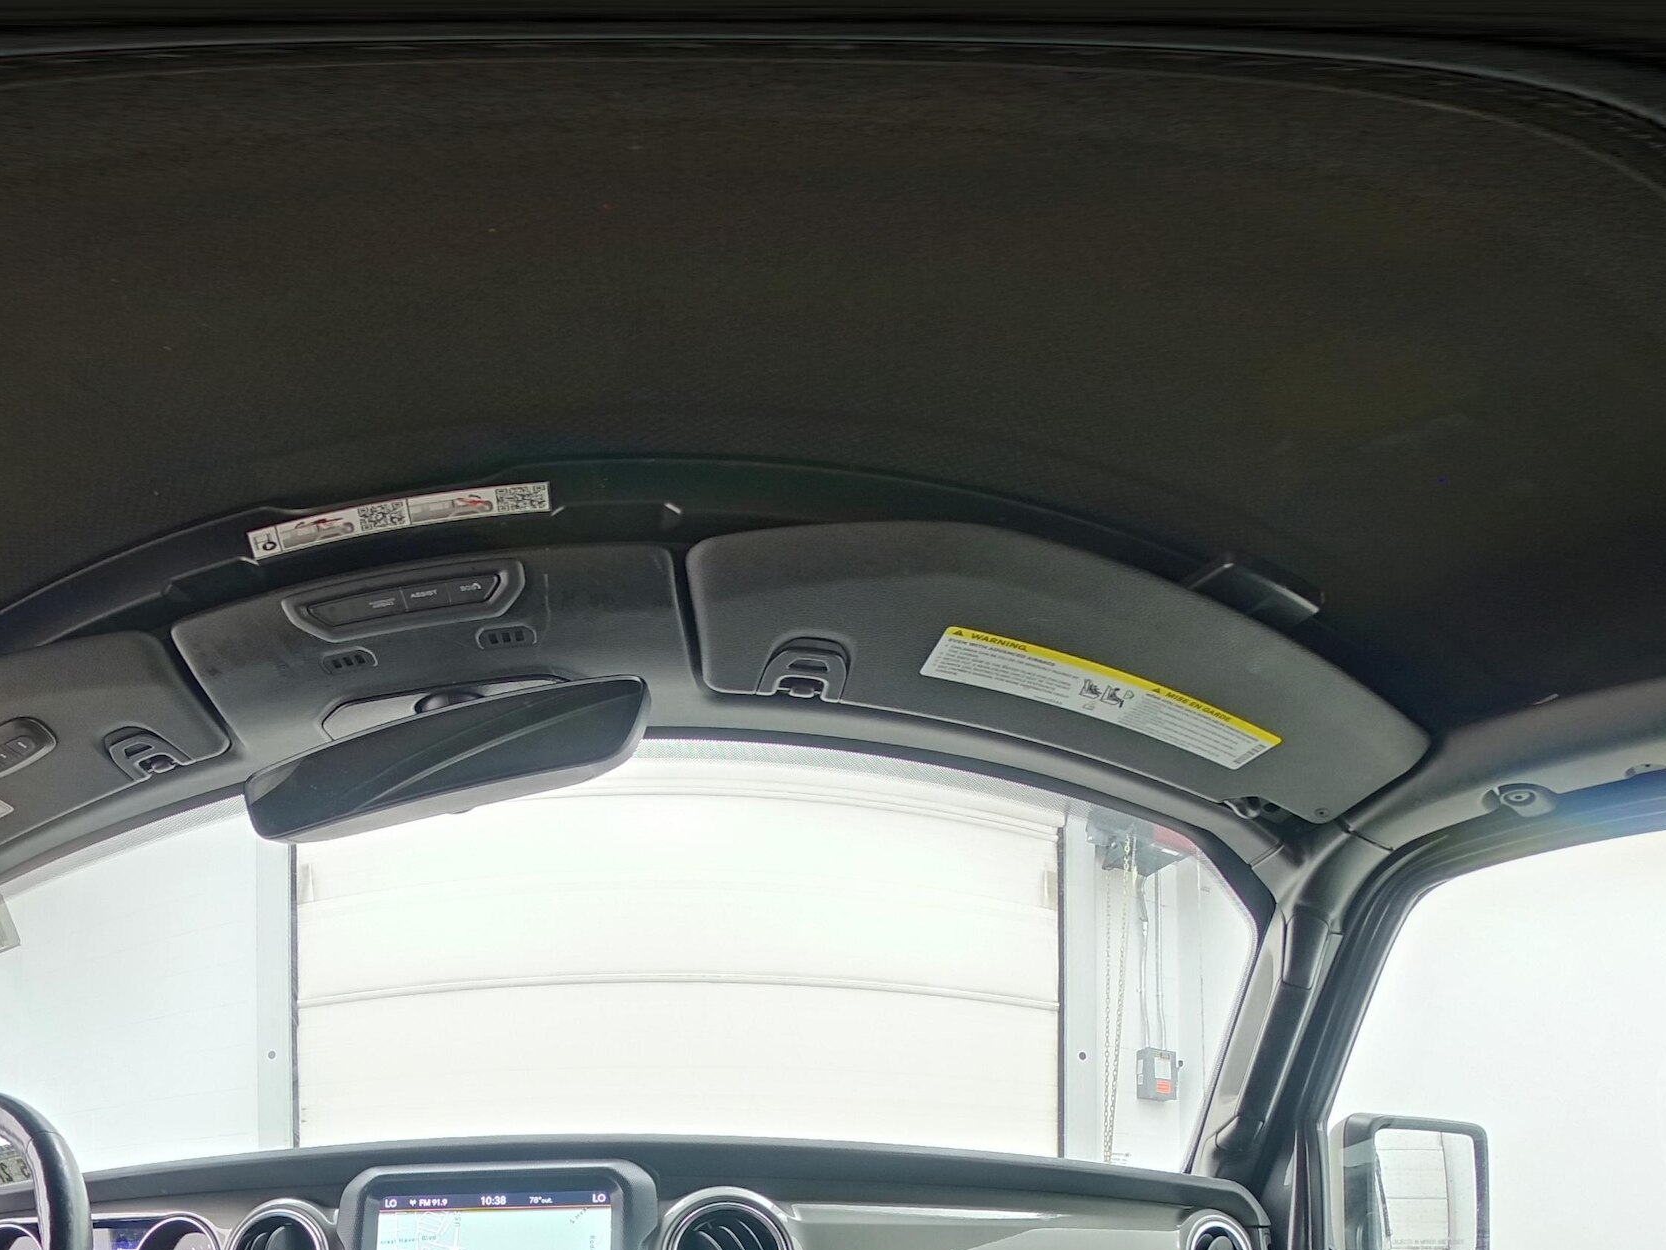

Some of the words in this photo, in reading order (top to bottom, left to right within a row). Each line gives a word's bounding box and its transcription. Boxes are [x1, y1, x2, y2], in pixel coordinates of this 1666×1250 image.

[410, 589, 437, 598] ASSIST
[971, 632, 1028, 652] WARNING
[1165, 691, 1189, 703] MISE
[1189, 700, 1202, 709] EN
[1202, 707, 1231, 722] GARDE
[419, 1199, 431, 1207] FM
[432, 1198, 448, 1206] 91.9
[480, 1195, 507, 1206] 10:38
[592, 1193, 606, 1203] LO
[385, 1199, 397, 1208] LO
